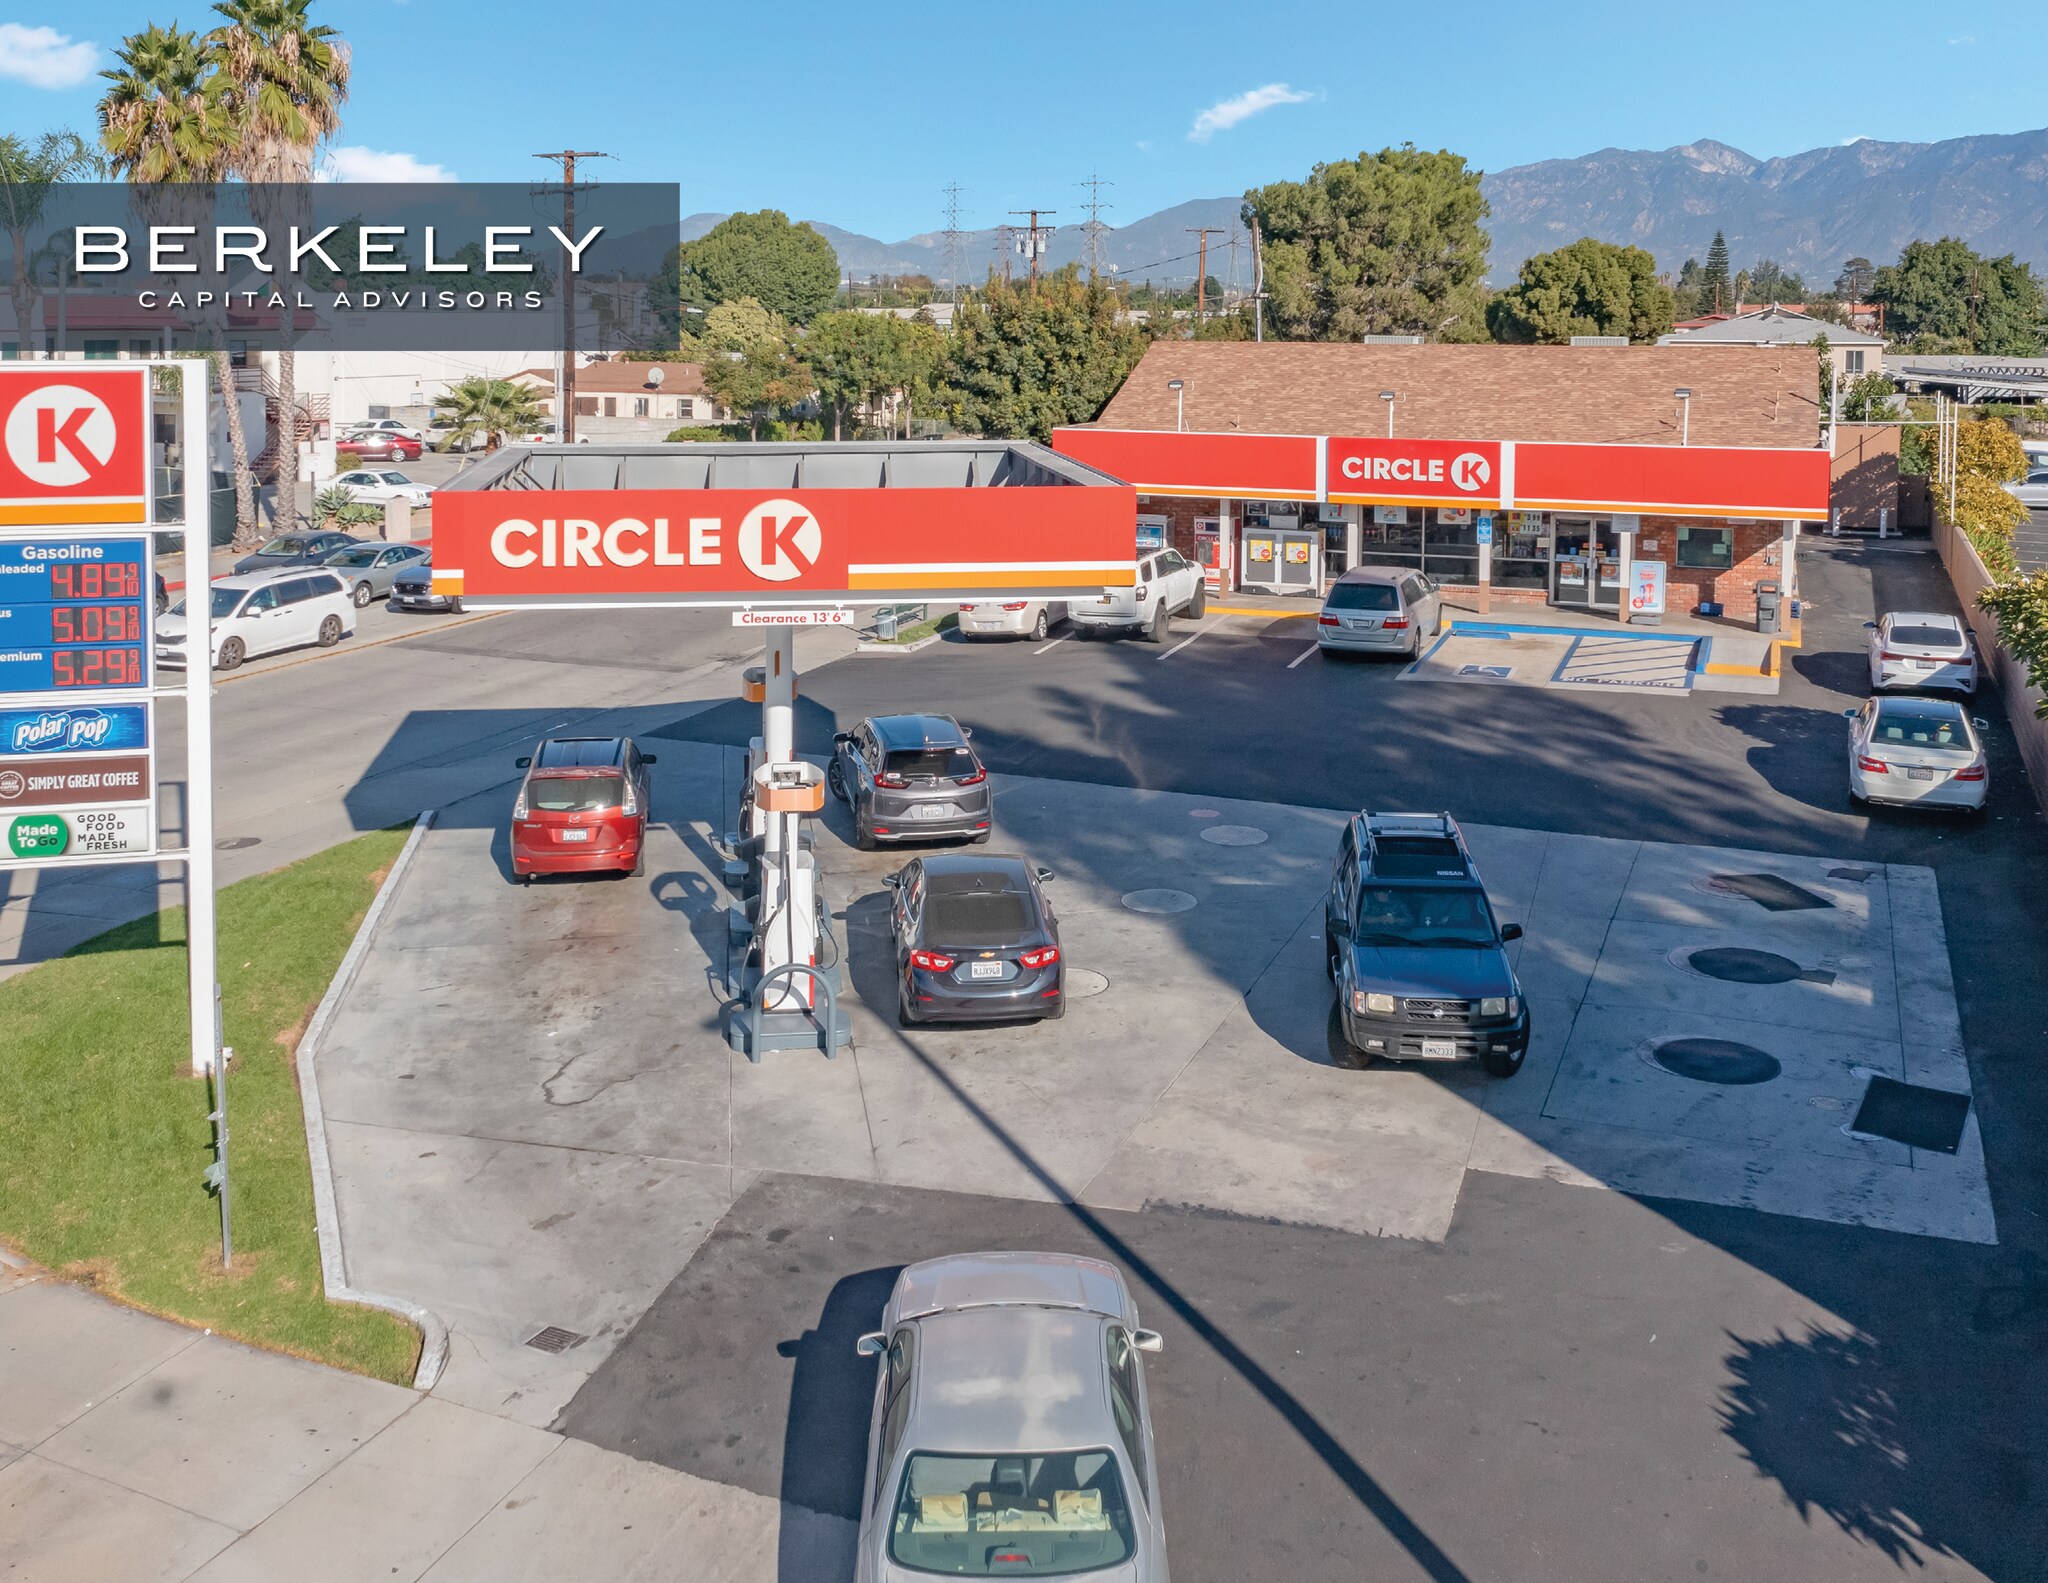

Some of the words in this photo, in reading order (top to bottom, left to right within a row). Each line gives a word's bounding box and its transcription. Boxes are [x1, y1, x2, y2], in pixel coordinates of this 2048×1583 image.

[37, 407, 111, 481] K
[1341, 456, 1444, 482] CIRCLE
[1460, 458, 1489, 487] K
[490, 517, 722, 569] CIRCLE
[761, 515, 812, 573] K
[22, 545, 104, 560] Gasoline
[0, 563, 45, 575] leaded
[52, 564, 126, 598] 4.89
[53, 607, 126, 642] 5.09
[742, 613, 807, 624] Clearance
[53, 649, 127, 686] 5.29
[1597, 678, 1677, 688] PARKING
[17, 717, 66, 747] Polar
[71, 716, 109, 743] Pop
[28, 775, 65, 790] SIMPLY
[68, 773, 101, 788] GREAT
[103, 771, 139, 787] COFFEE
[77, 813, 116, 823] GOOD
[17, 824, 58, 836] Made
[86, 821, 125, 832] FOOD
[77, 832, 115, 843] MADE
[86, 840, 128, 851] FRESH
